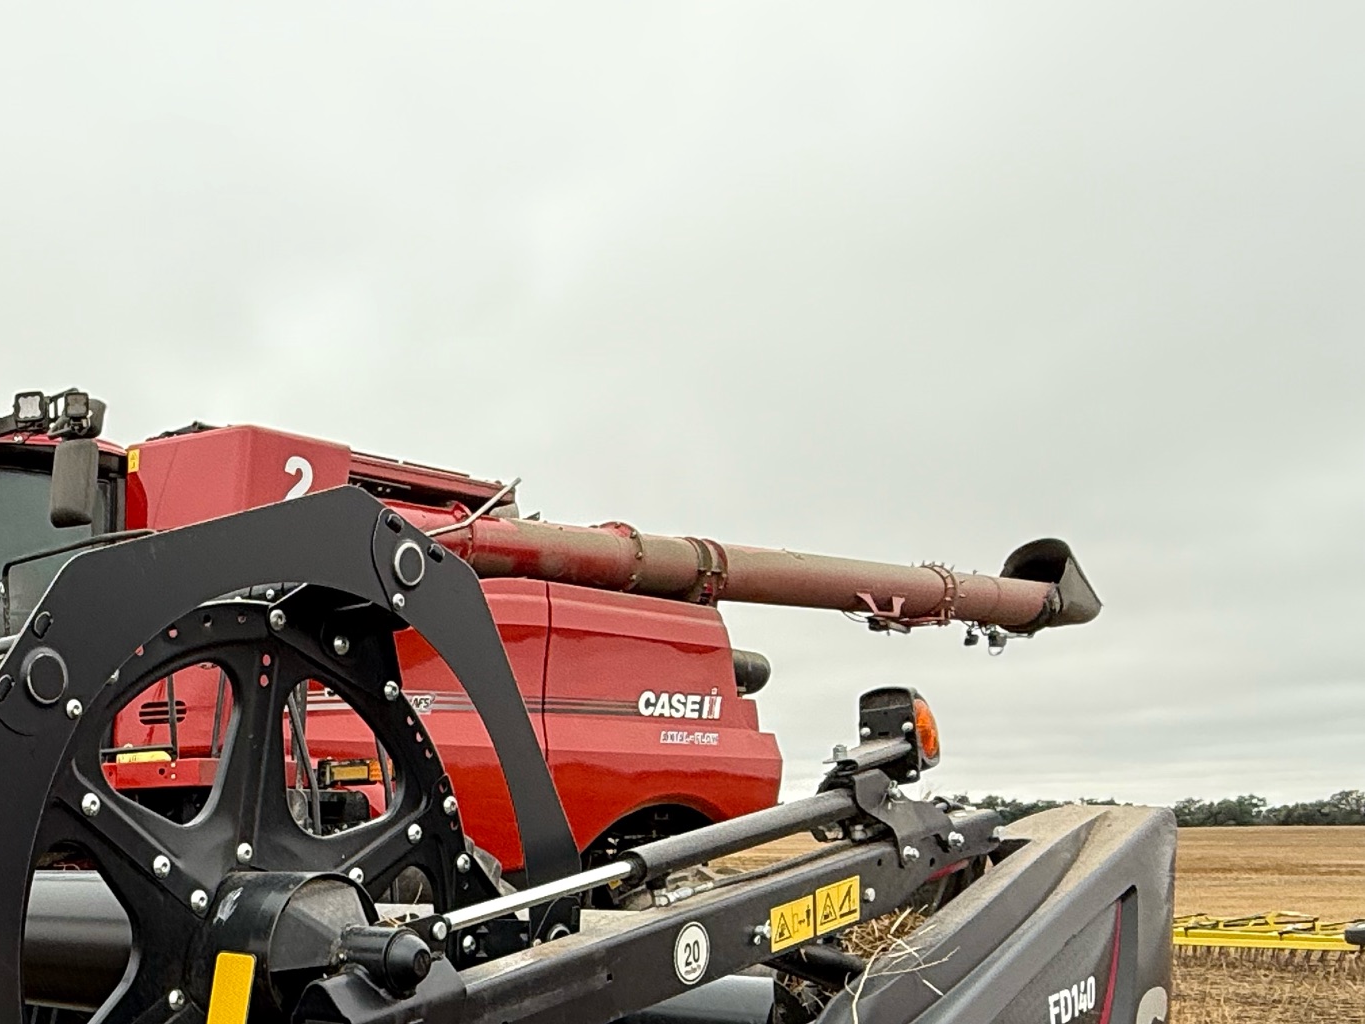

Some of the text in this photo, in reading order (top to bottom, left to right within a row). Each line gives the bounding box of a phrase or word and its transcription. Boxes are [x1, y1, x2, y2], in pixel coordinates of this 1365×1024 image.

[284, 456, 313, 501] 2
[638, 691, 701, 719] CASE
[684, 940, 700, 967] 20
